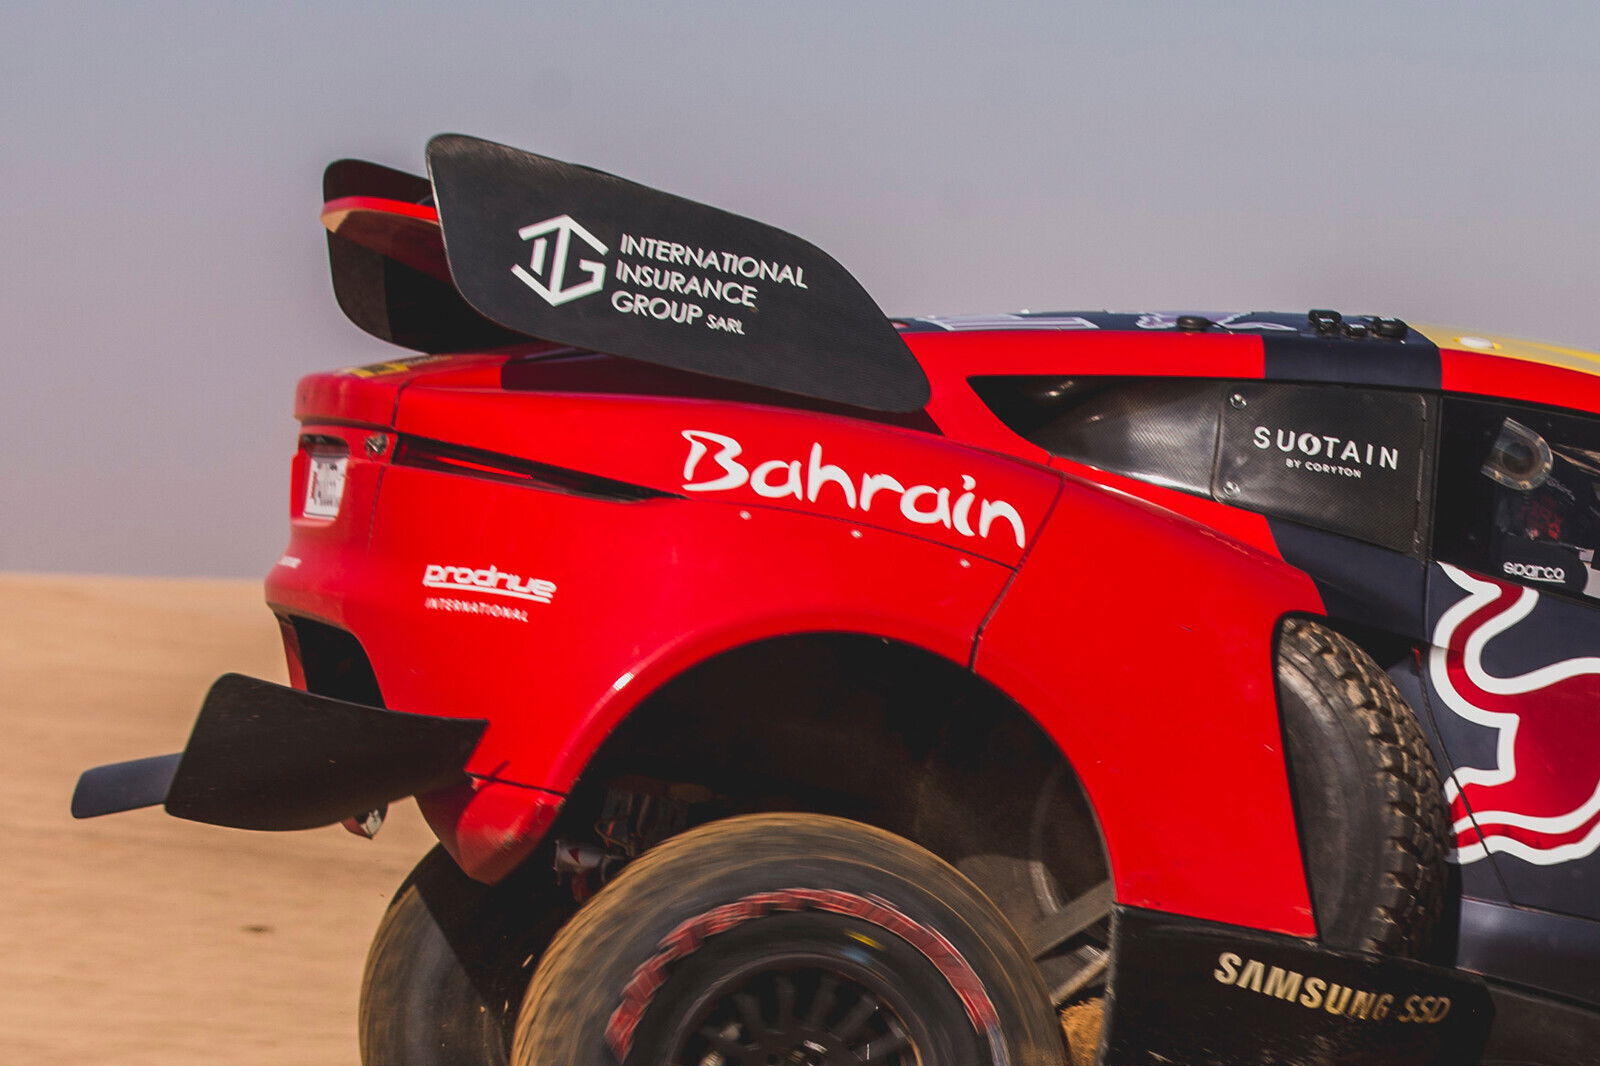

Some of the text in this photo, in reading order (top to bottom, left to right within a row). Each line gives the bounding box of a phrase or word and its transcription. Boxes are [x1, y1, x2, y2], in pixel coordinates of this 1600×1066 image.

[615, 259, 758, 308] INSURANCE
[620, 233, 808, 289] INTERNATIONAL
[611, 290, 746, 335] GROUP SARL
[681, 429, 1026, 549] Bahrain
[1285, 458, 1362, 478] BY CORYTON
[1503, 561, 1566, 581] sparco
[1214, 951, 1451, 1025] SAMSUNG SSD
